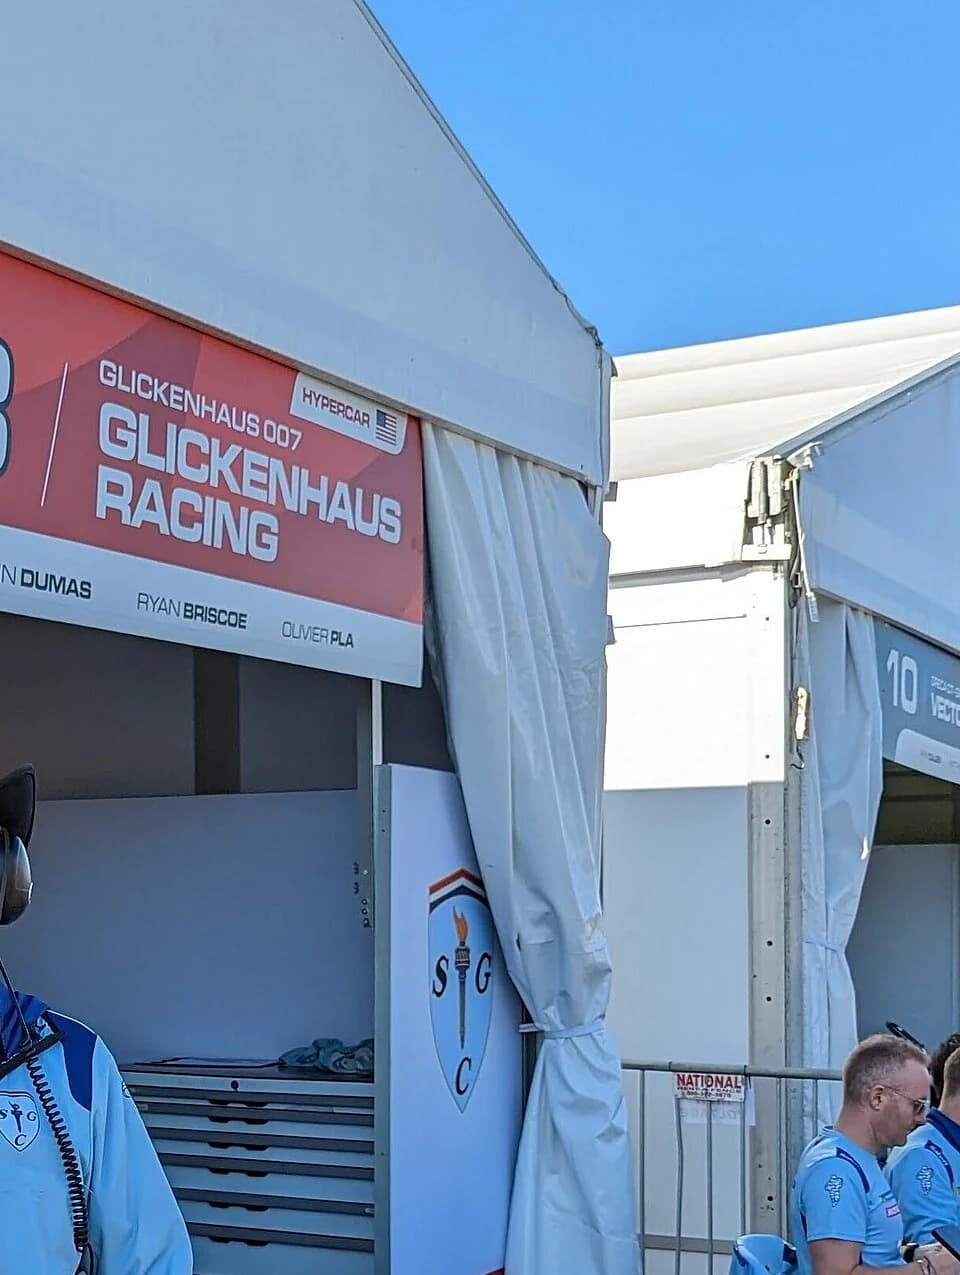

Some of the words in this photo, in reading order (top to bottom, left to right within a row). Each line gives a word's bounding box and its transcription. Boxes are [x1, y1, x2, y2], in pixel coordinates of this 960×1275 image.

[99, 359, 260, 437] GLICKENHAUS
[263, 420, 303, 451] 007
[302, 387, 371, 429] HYPERCAR
[99, 402, 401, 545] GLICKENHAUS
[95, 464, 279, 563] RACING
[20, 567, 92, 600] DUMAS
[137, 592, 181, 616] RYAN
[183, 598, 248, 630] BRISCOE
[282, 621, 329, 644] OLIVIER
[330, 630, 354, 649] PLA
[886, 649, 918, 715] 10
[432, 955, 449, 997] S
[475, 952, 491, 994] G
[455, 1056, 472, 1096] C
[676, 1074, 742, 1089] NATIONAL
[26, 1111, 38, 1122] G
